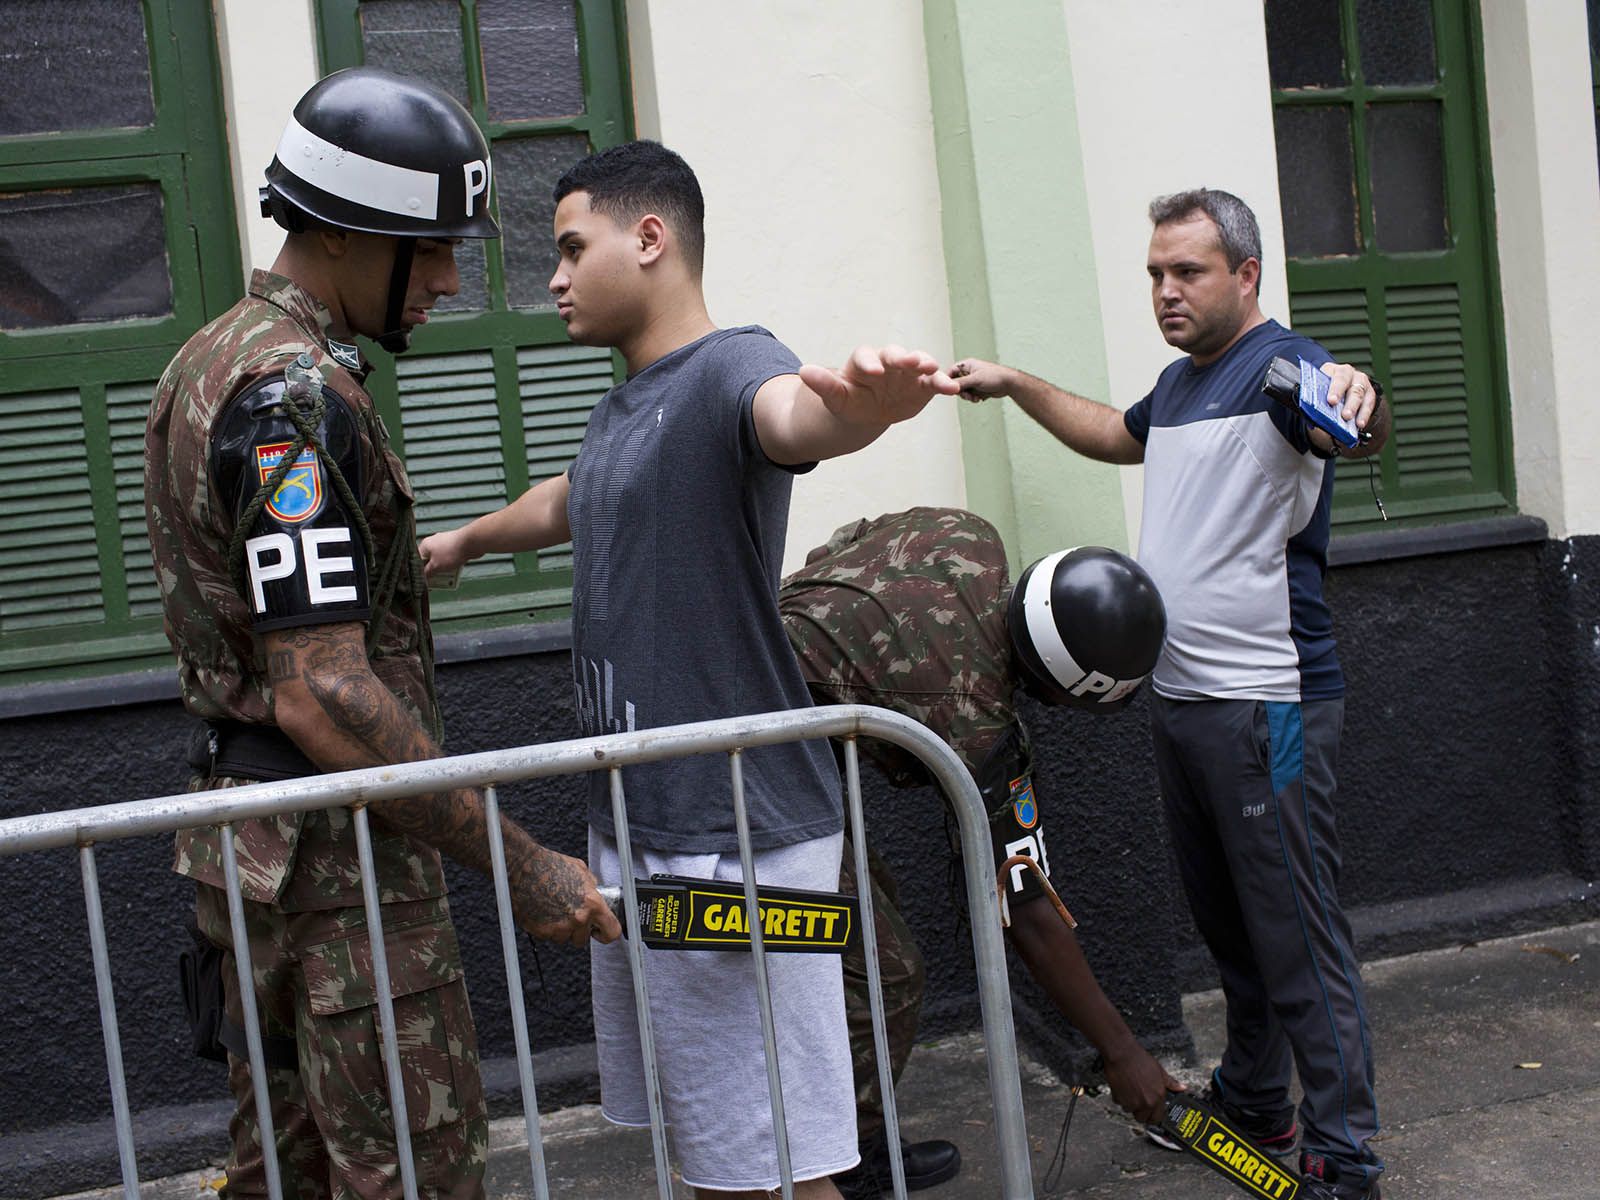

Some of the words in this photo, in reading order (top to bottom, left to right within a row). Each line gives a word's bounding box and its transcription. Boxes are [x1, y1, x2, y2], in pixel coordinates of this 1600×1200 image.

[463, 157, 492, 217] P
[245, 527, 358, 614] PE
[655, 898, 666, 933] GARRETT
[663, 895, 674, 938] SCANNER
[670, 900, 680, 934] SUPER
[1207, 1132, 1291, 1198] GARRETT
